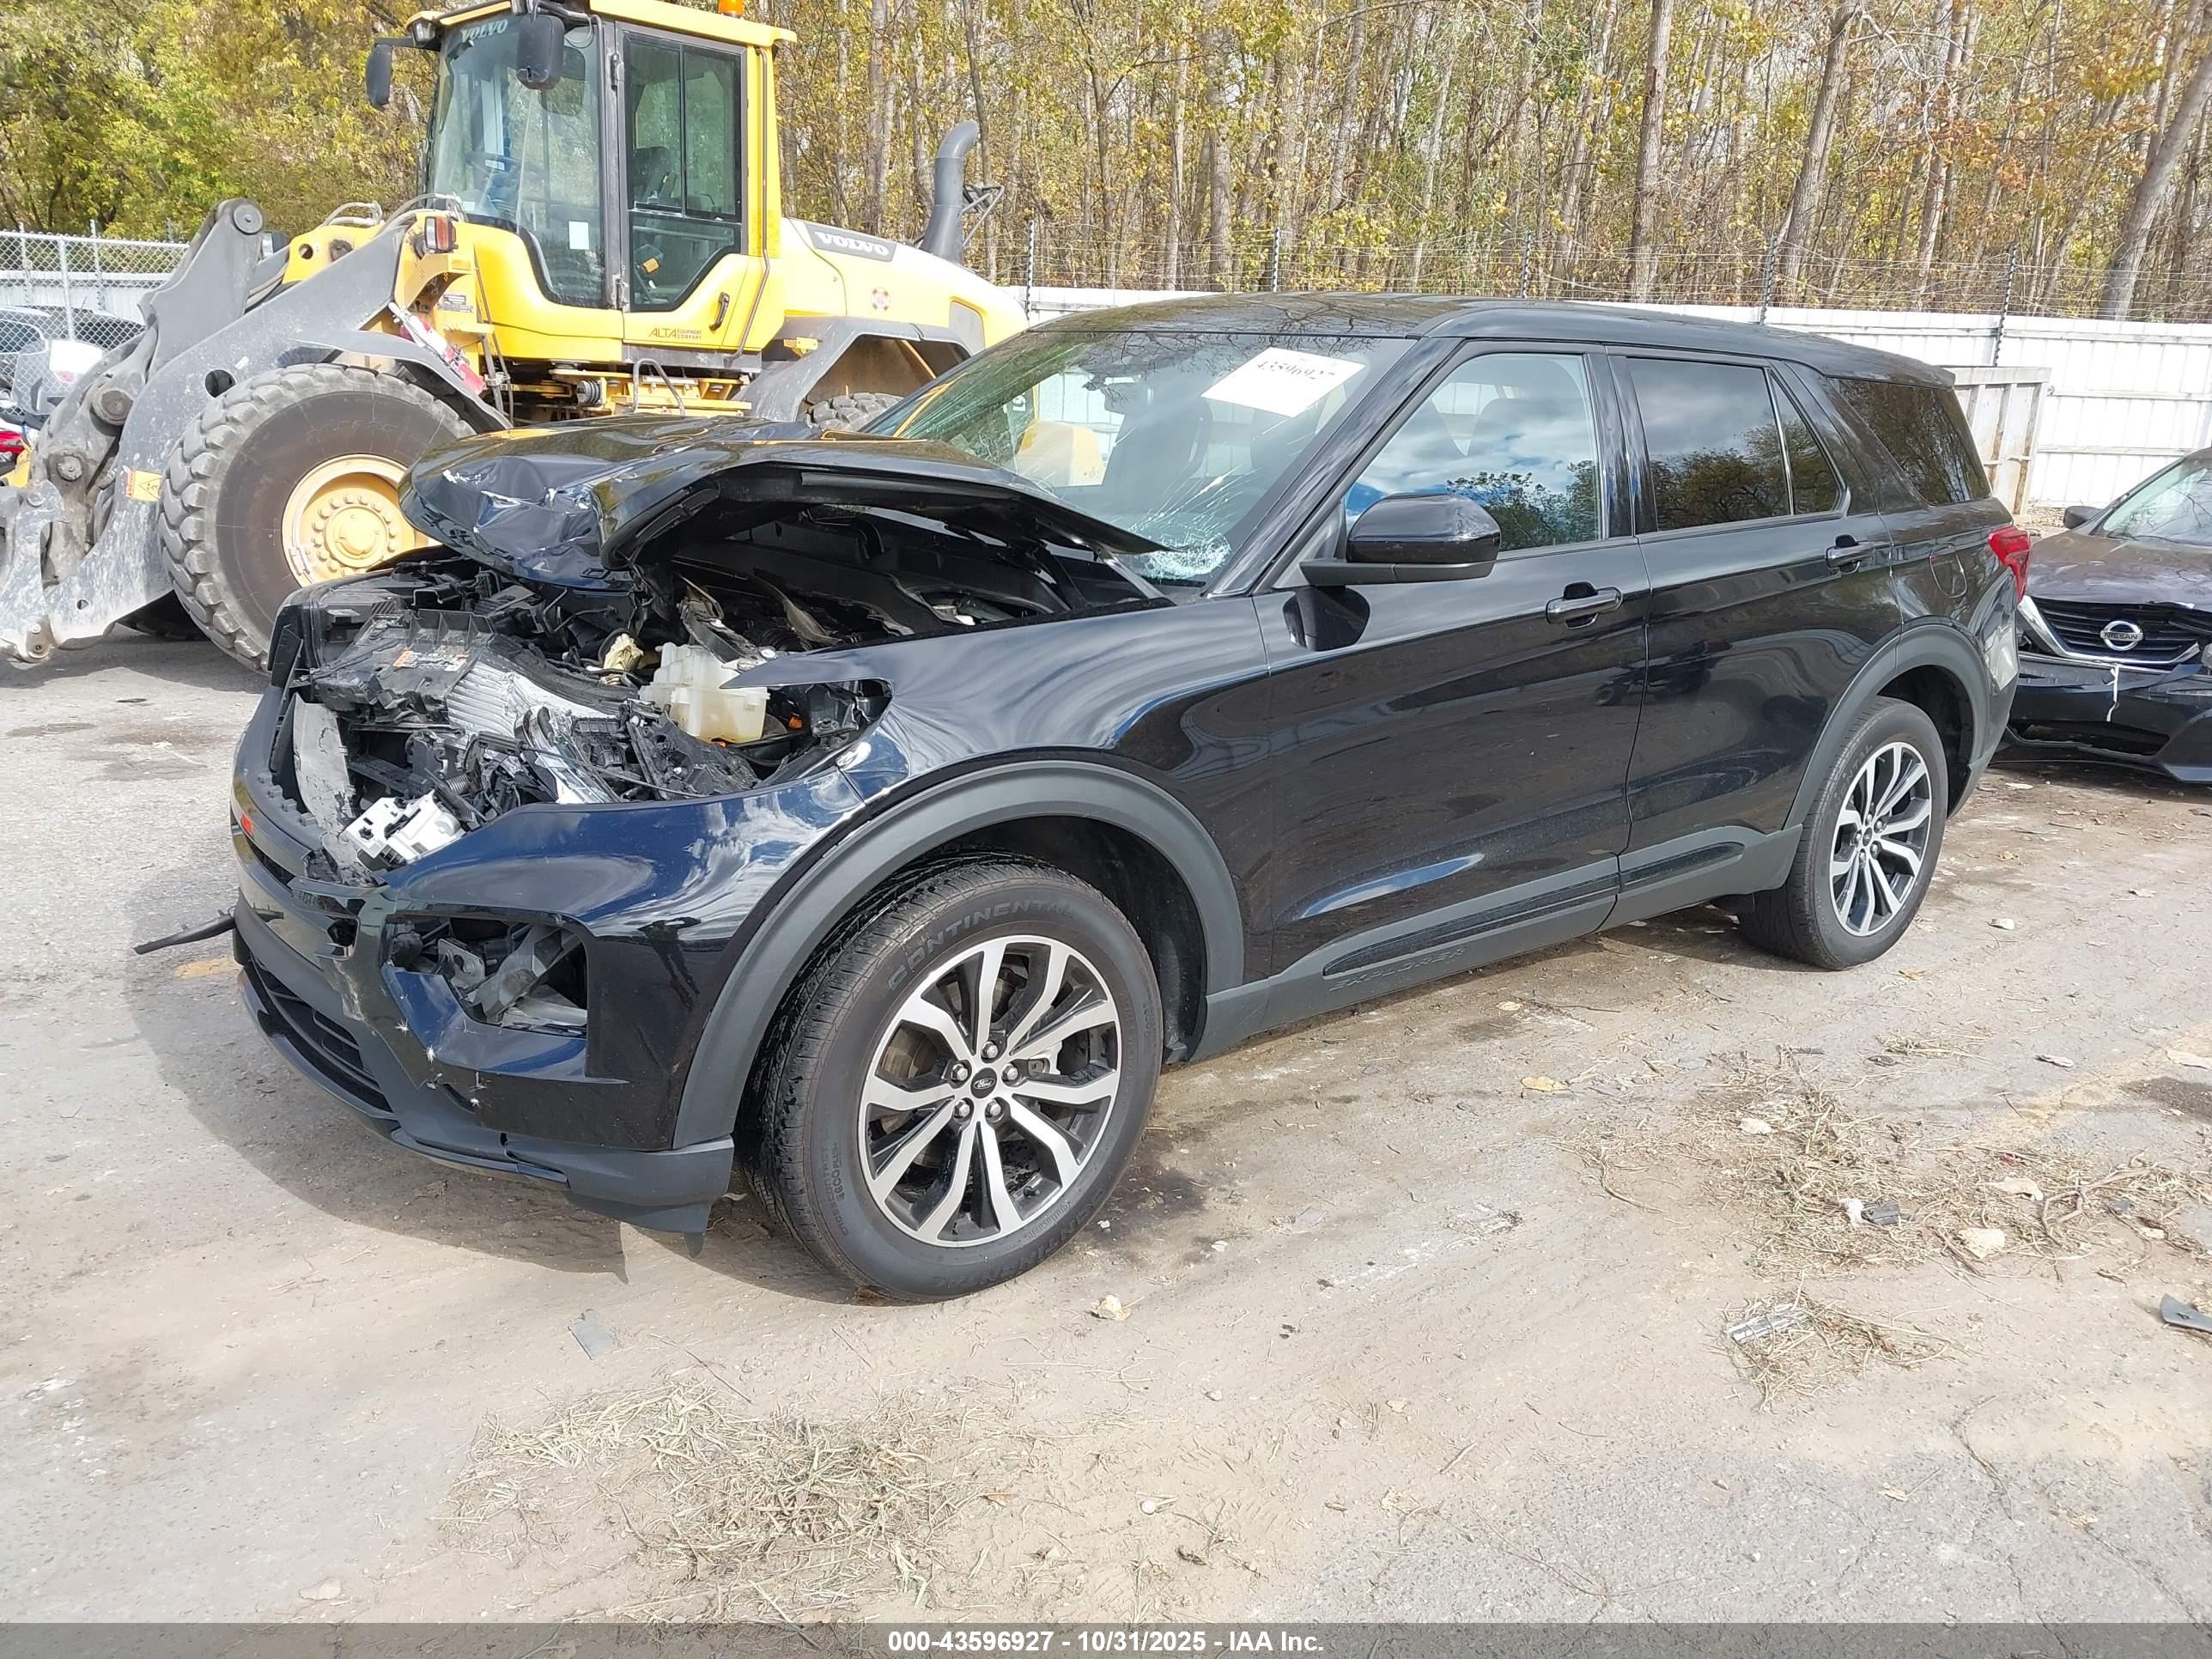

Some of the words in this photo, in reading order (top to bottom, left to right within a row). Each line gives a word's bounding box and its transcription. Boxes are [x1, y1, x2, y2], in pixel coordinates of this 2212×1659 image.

[460, 19, 508, 43] VOLVO
[814, 231, 890, 256] VOLVO
[648, 327, 677, 338] ALTA
[888, 902, 1076, 989] CONTINENTAL
[1329, 948, 1465, 992] EXPLORER
